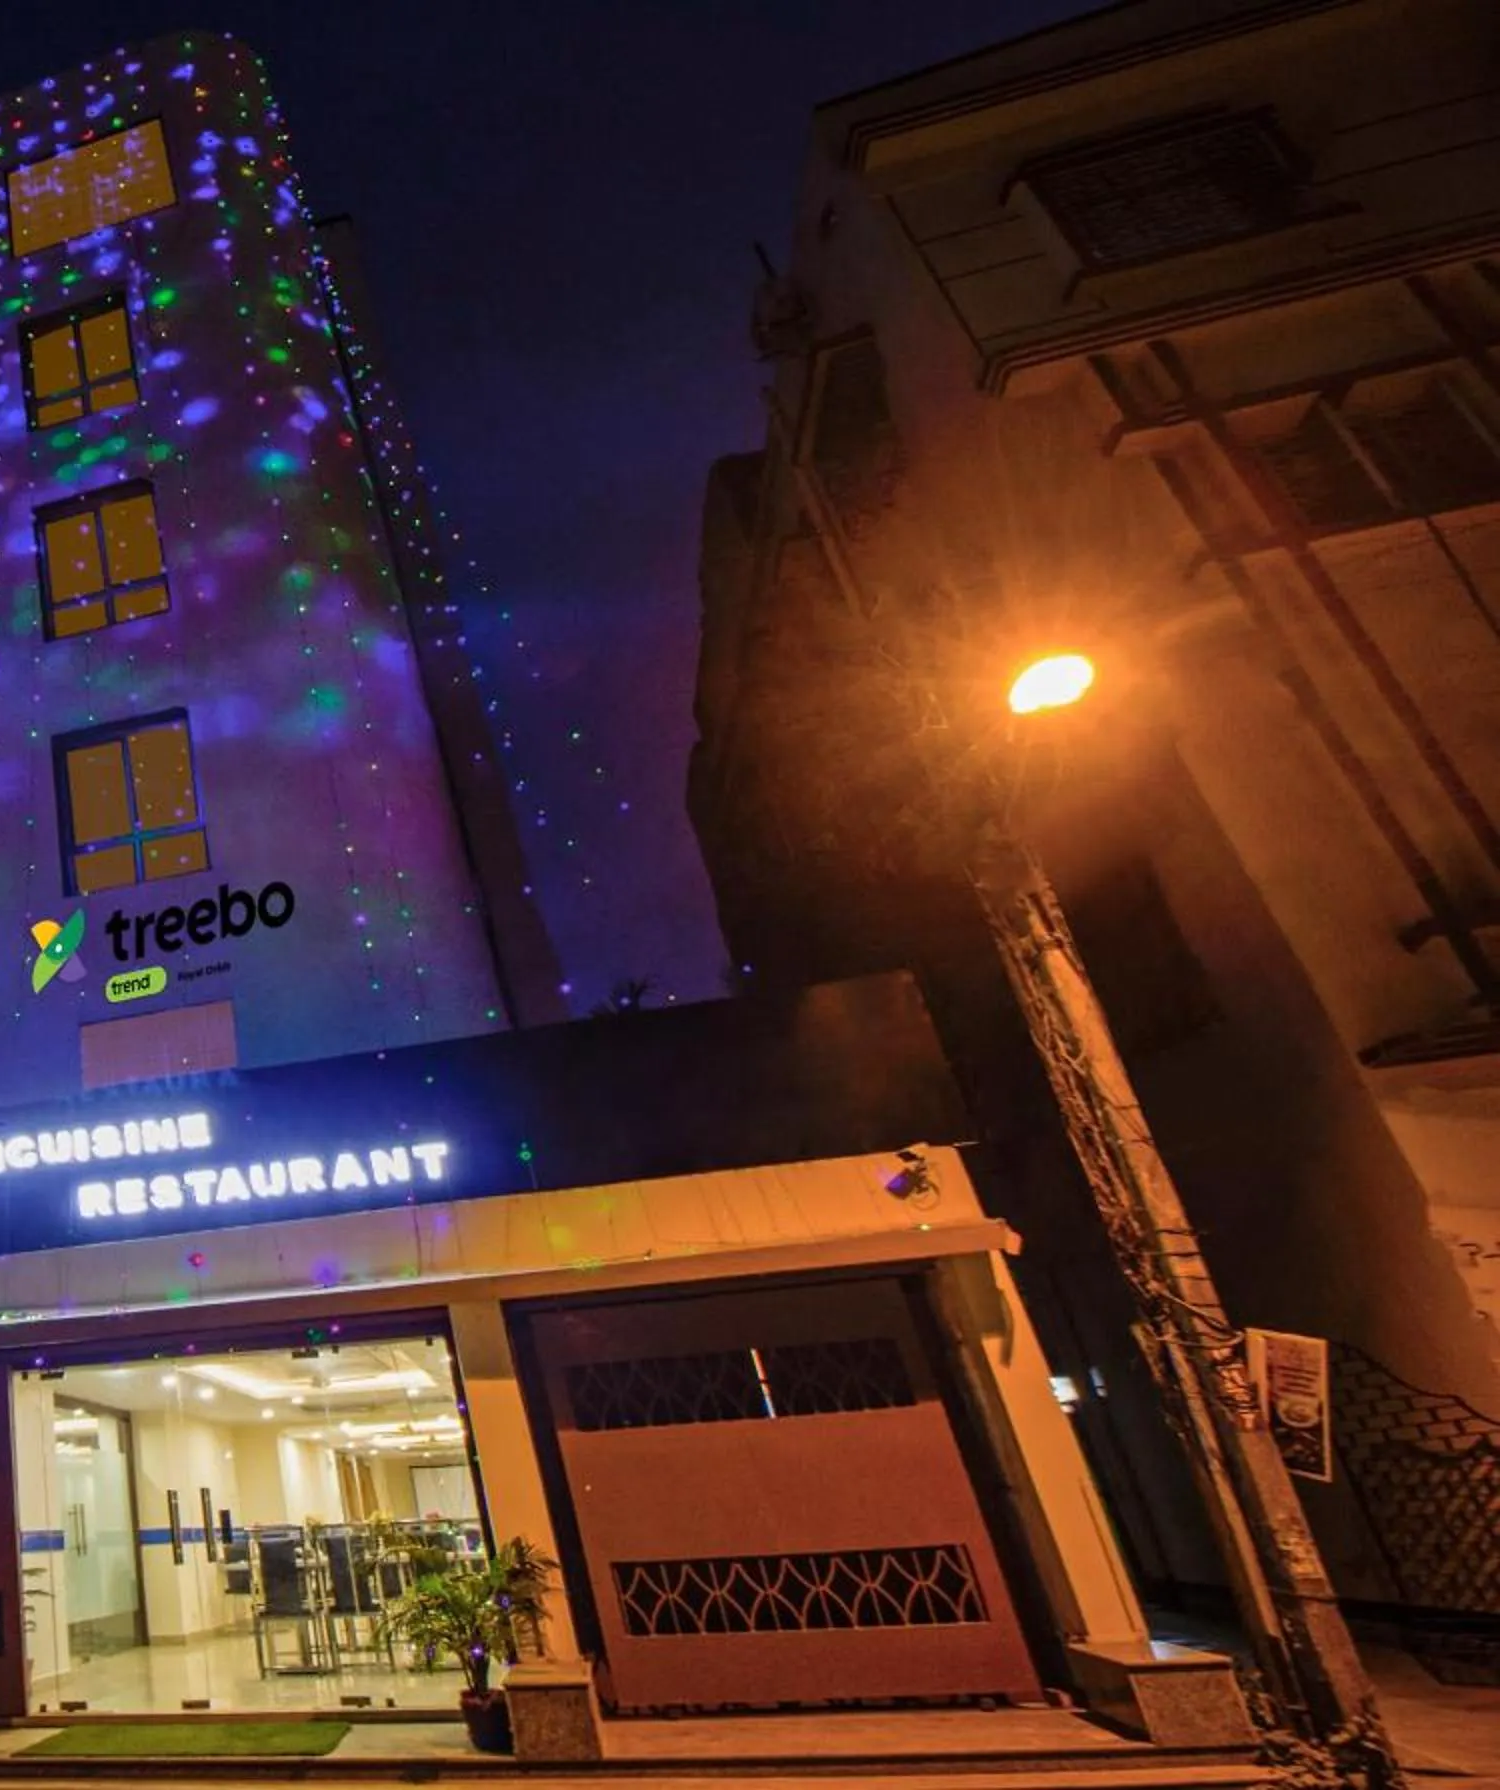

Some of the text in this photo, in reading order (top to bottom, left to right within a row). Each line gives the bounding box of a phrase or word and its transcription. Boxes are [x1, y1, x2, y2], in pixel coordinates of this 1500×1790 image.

[105, 882, 295, 961] treebo
[111, 973, 151, 996] trend
[78, 1142, 448, 1218] RESTAURANT
